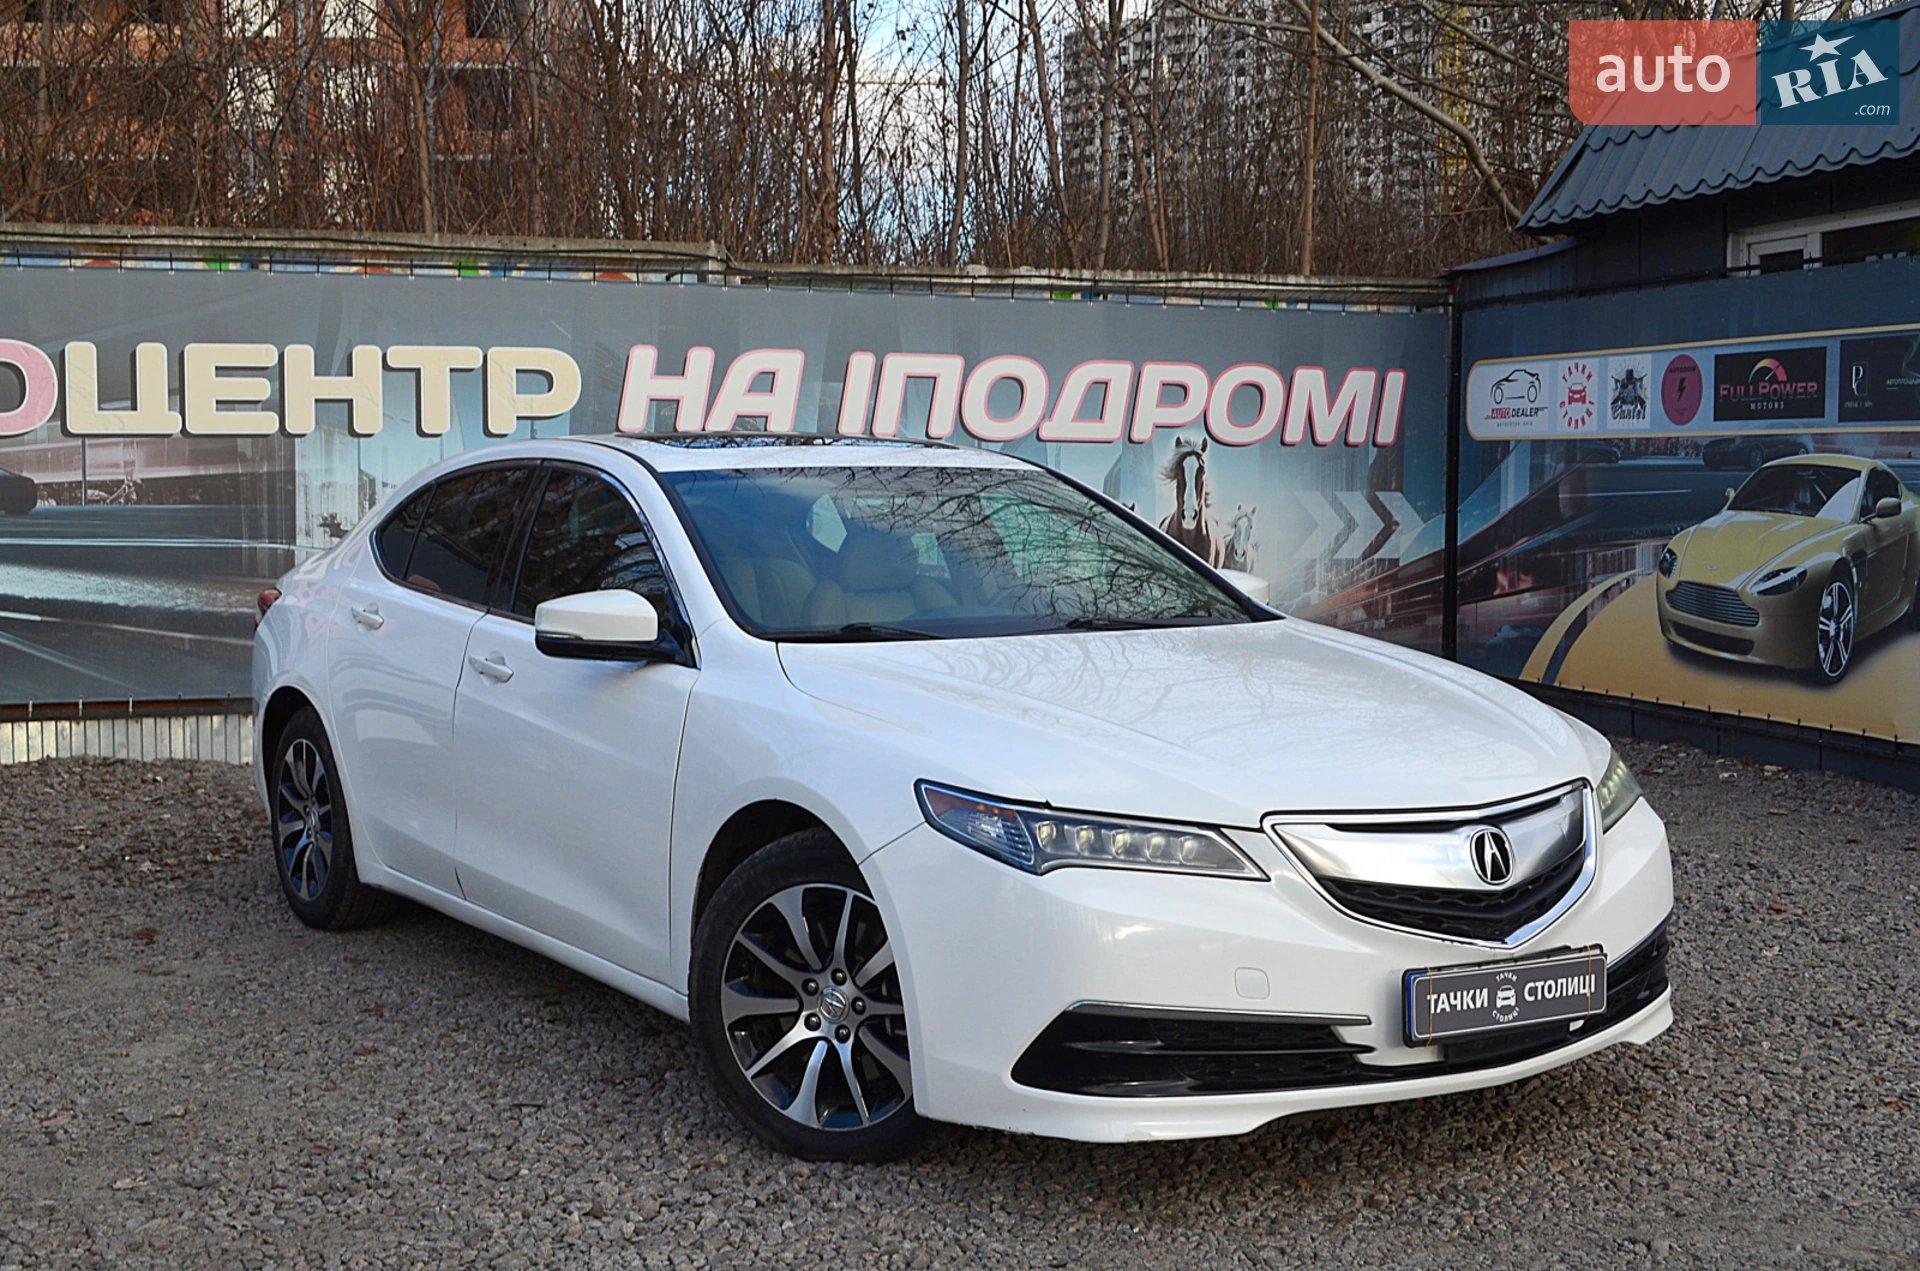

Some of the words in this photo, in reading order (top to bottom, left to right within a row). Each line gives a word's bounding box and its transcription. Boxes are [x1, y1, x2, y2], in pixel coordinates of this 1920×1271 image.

[617, 344, 805, 433] НА
[838, 350, 1407, 447] ІПОДРОМІ
[1750, 401, 1785, 410] MOTORS
[1427, 987, 1489, 1014] ТАЧКИ
[1523, 973, 1596, 1002] СТОЛИЦІ
